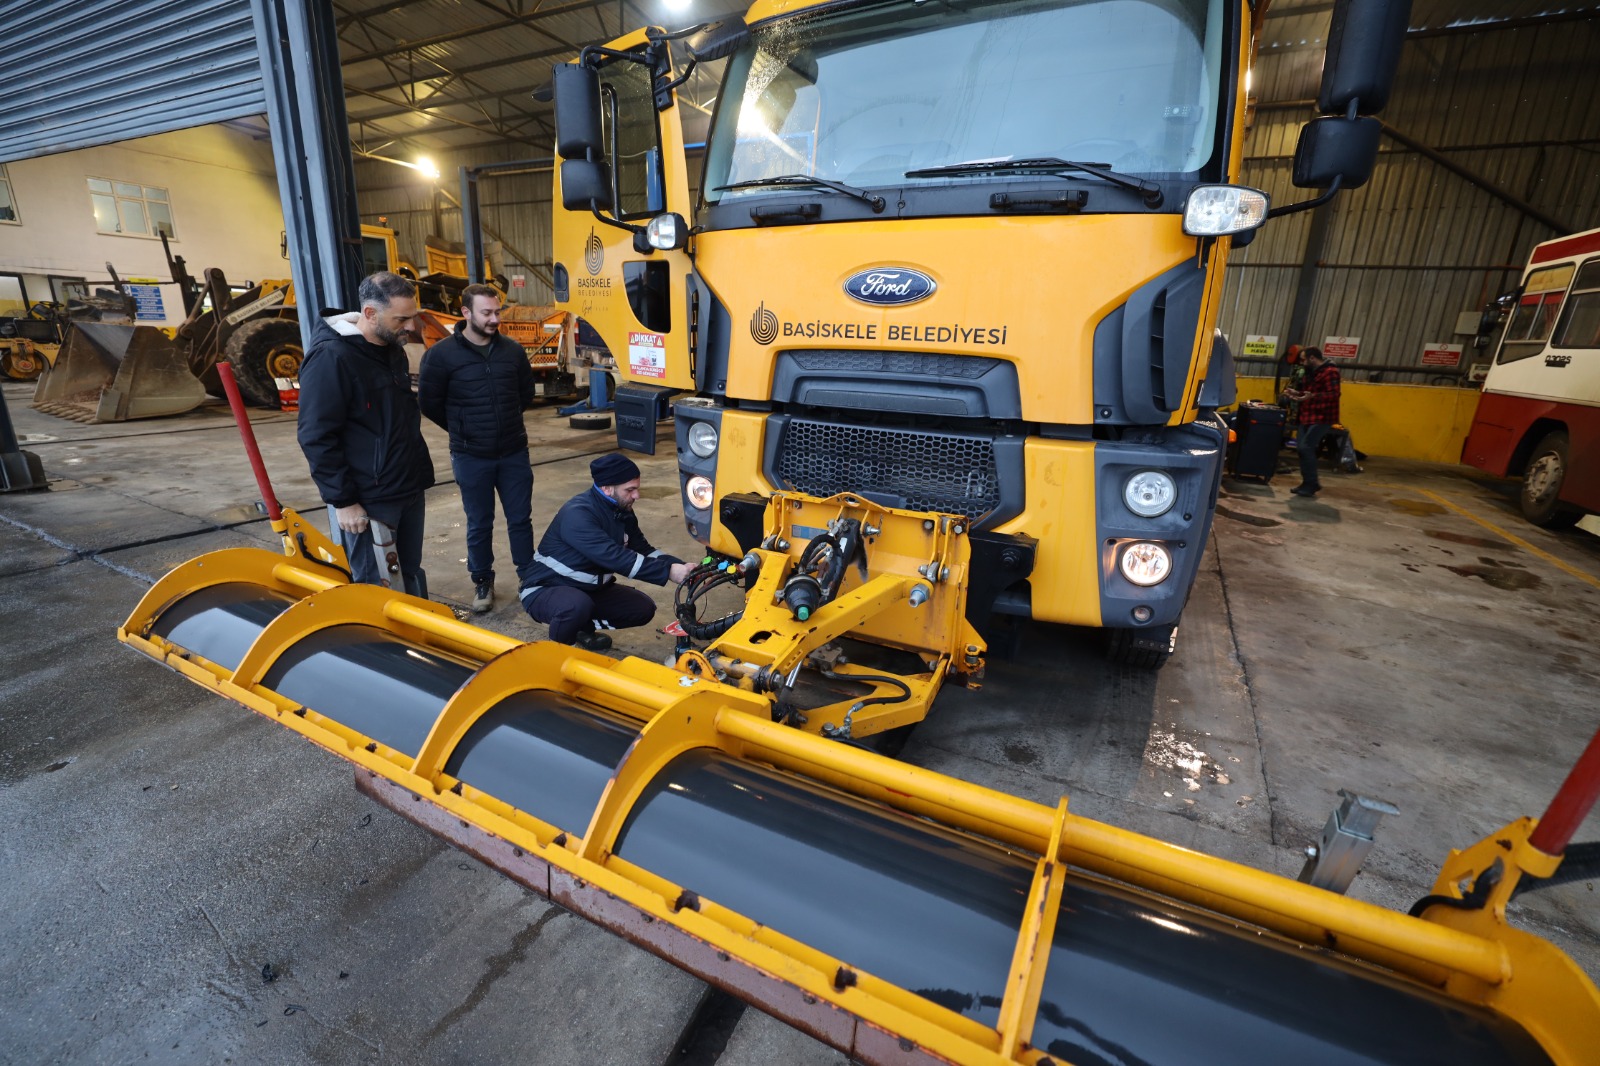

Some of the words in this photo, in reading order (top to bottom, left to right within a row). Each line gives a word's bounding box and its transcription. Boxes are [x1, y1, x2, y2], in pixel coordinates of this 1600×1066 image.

[578, 276, 611, 288] BAŞİSKELE
[860, 273, 911, 296] Ford
[634, 333, 657, 343] DİKKAT
[782, 320, 877, 340] BAŞİSKELE
[888, 323, 1008, 345] BELEDİYESİ
